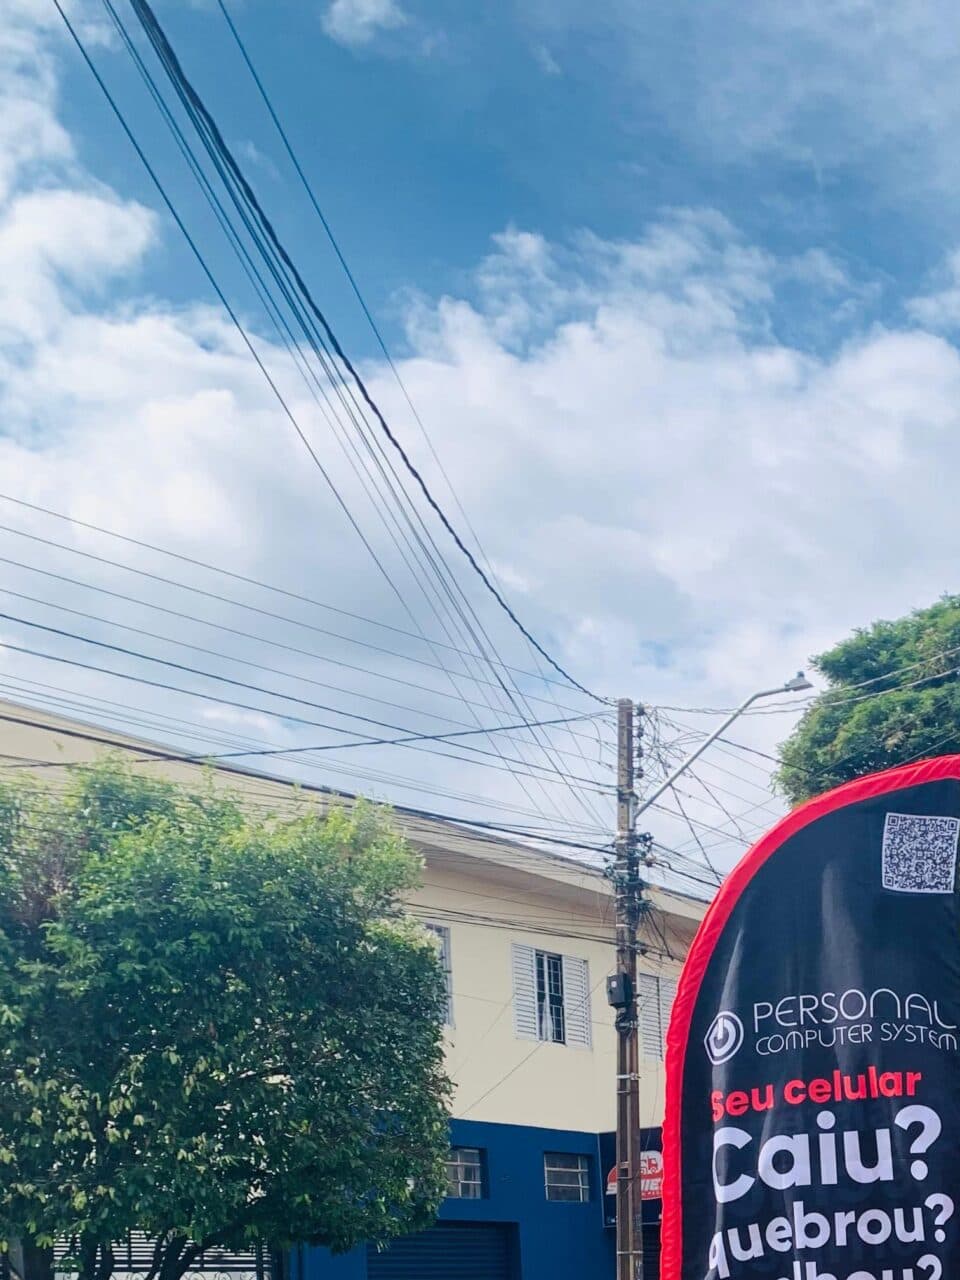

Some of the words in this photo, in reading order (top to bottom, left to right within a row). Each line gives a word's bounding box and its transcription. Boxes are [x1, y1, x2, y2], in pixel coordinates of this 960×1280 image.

[753, 987, 958, 1033] PERSONAL
[755, 1024, 873, 1057] COMPUTER
[879, 1021, 958, 1051] SYSTEM
[783, 1065, 922, 1105] celular
[712, 1104, 942, 1204] Caiu?
